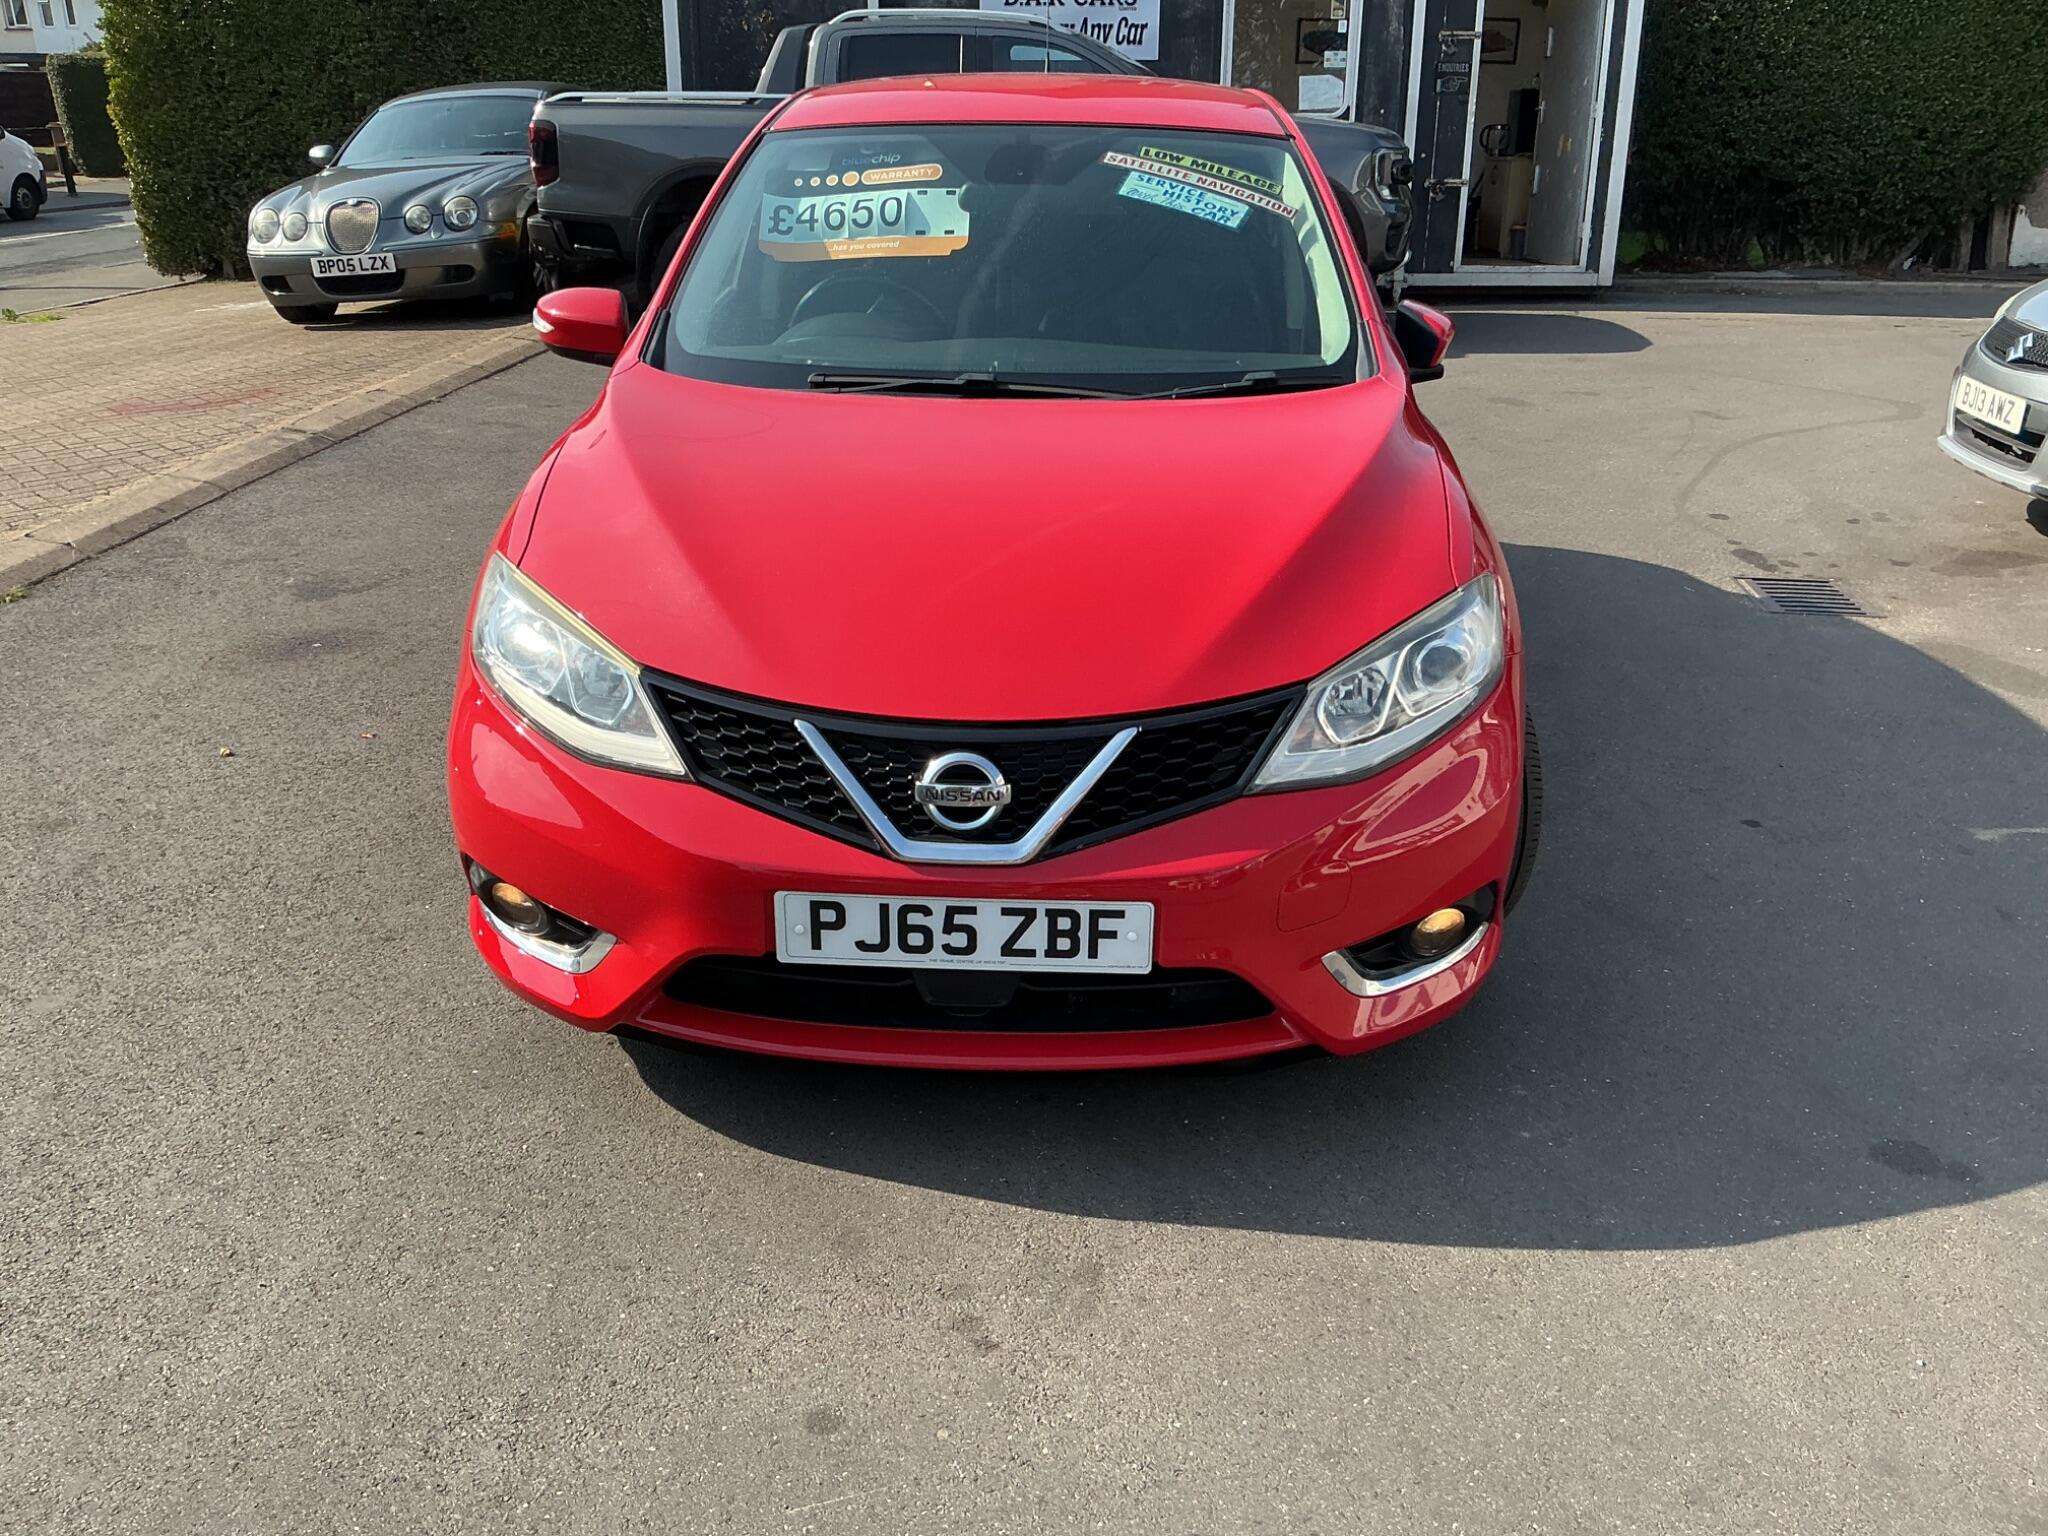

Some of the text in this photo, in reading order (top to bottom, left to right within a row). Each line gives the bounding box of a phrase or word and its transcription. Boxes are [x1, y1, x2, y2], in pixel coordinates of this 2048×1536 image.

[1116, 16, 1149, 46] Car
[870, 168, 935, 181] WARRANTY
[1107, 153, 1293, 216] SATELLITE NAVIGATION
[1142, 149, 1282, 194] LOW MILEAGE
[1136, 174, 1208, 199] SERVICE
[768, 197, 903, 236] £4650
[1162, 189, 1239, 217] HISTORY
[1191, 207, 1231, 224] CAR
[866, 240, 900, 249] covered
[317, 256, 390, 274] BP05 LZX
[1962, 382, 2016, 425] BJ13 AWZ
[925, 788, 1005, 802] NISSAN
[809, 900, 1126, 960] PJ65 ZBF
